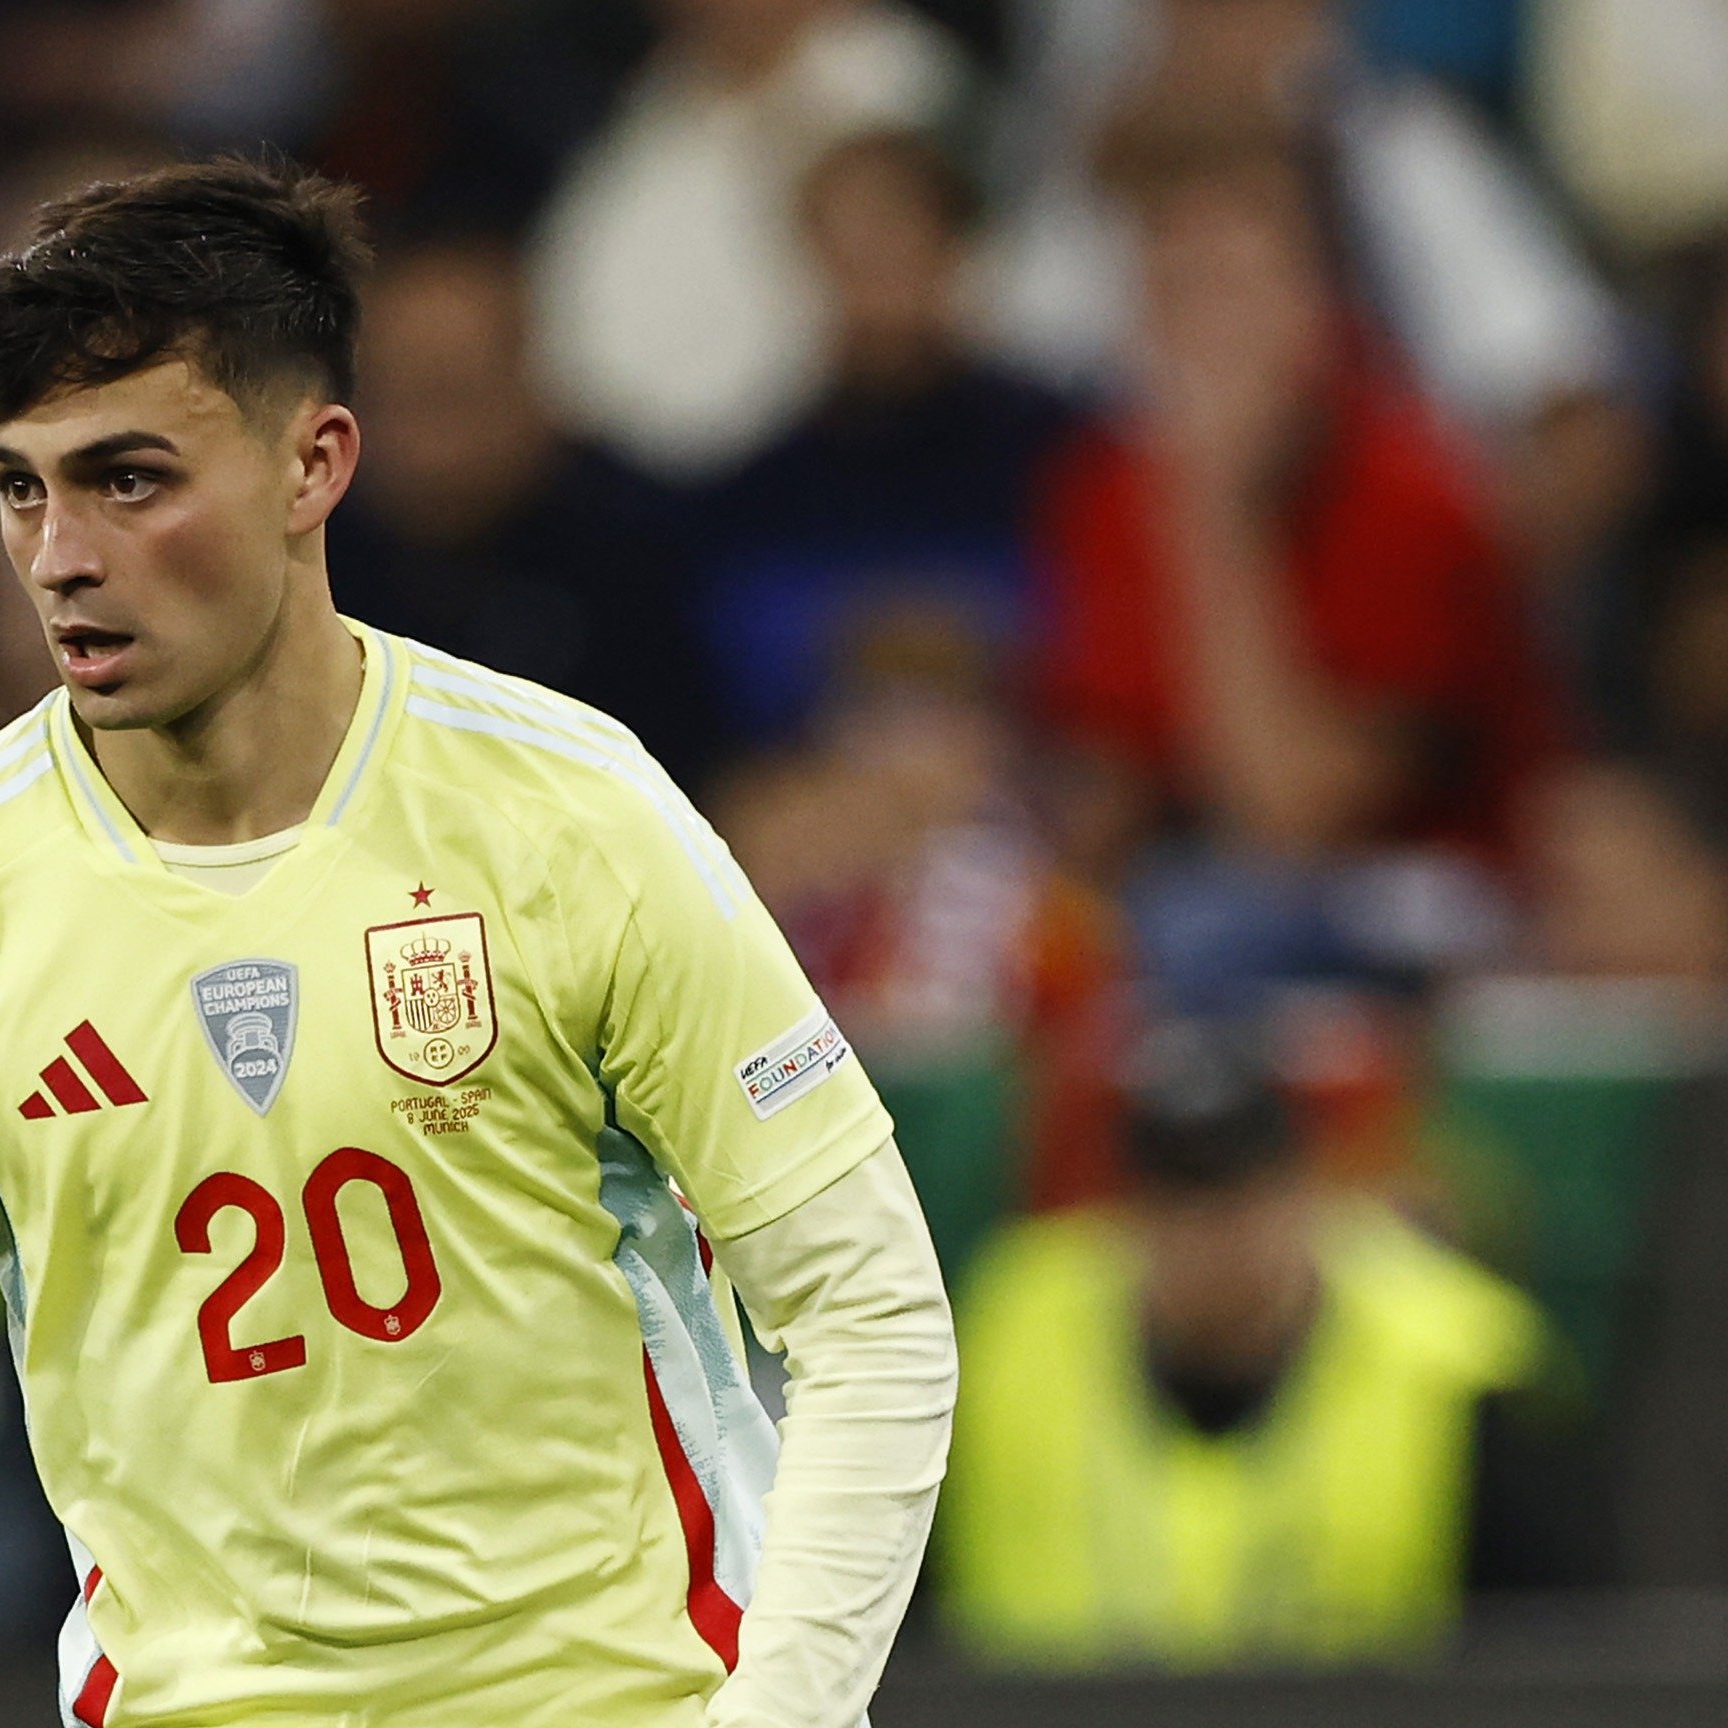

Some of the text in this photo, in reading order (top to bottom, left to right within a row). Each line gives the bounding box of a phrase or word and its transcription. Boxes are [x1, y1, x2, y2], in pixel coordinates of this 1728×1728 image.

[226, 966, 261, 981] UEFA
[201, 975, 288, 1001] EUROPEAN
[203, 992, 290, 1017] CHAMPIONS
[234, 1058, 278, 1079] 2024
[740, 1056, 769, 1080] UEFA
[390, 1096, 450, 1113] PORTUGAL
[460, 1087, 492, 1104] SPAIN
[407, 1103, 480, 1125] 8 JUNE 2025
[423, 1121, 469, 1136] MUNICH
[174, 1146, 442, 1384] 20
